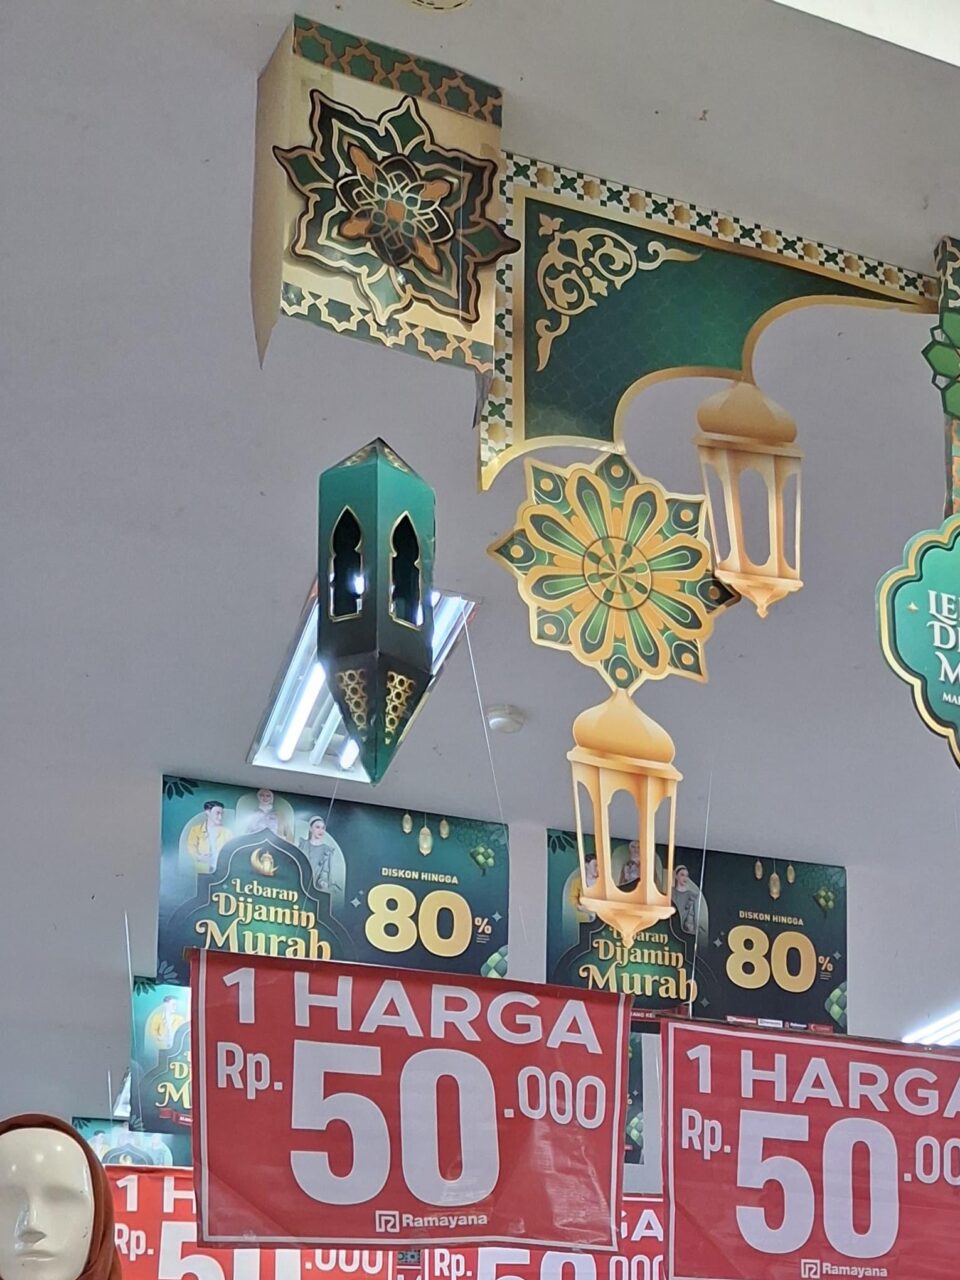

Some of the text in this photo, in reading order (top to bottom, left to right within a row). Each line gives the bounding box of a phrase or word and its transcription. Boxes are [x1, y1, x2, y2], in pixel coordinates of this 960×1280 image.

[231, 877, 298, 904] Lebaran
[381, 866, 459, 885] DISKON HINGGA
[212, 892, 315, 929] Dijamin
[738, 909, 804, 926] DISKON HINGGA
[195, 918, 331, 961] Murah
[593, 938, 683, 968] Dijamin
[579, 964, 697, 1003] Murah
[222, 967, 602, 1055] 1 HARGA
[686, 1043, 712, 1095] 1
[217, 1041, 283, 1100] Rp.
[290, 1039, 500, 1207] 50
[116, 1174, 139, 1213] 1
[681, 1107, 731, 1160] Rp.
[735, 1109, 899, 1259] 50
[401, 1212, 488, 1230] Ramayana
[114, 1223, 154, 1261] Rp.
[821, 1262, 888, 1278] Ramayana
